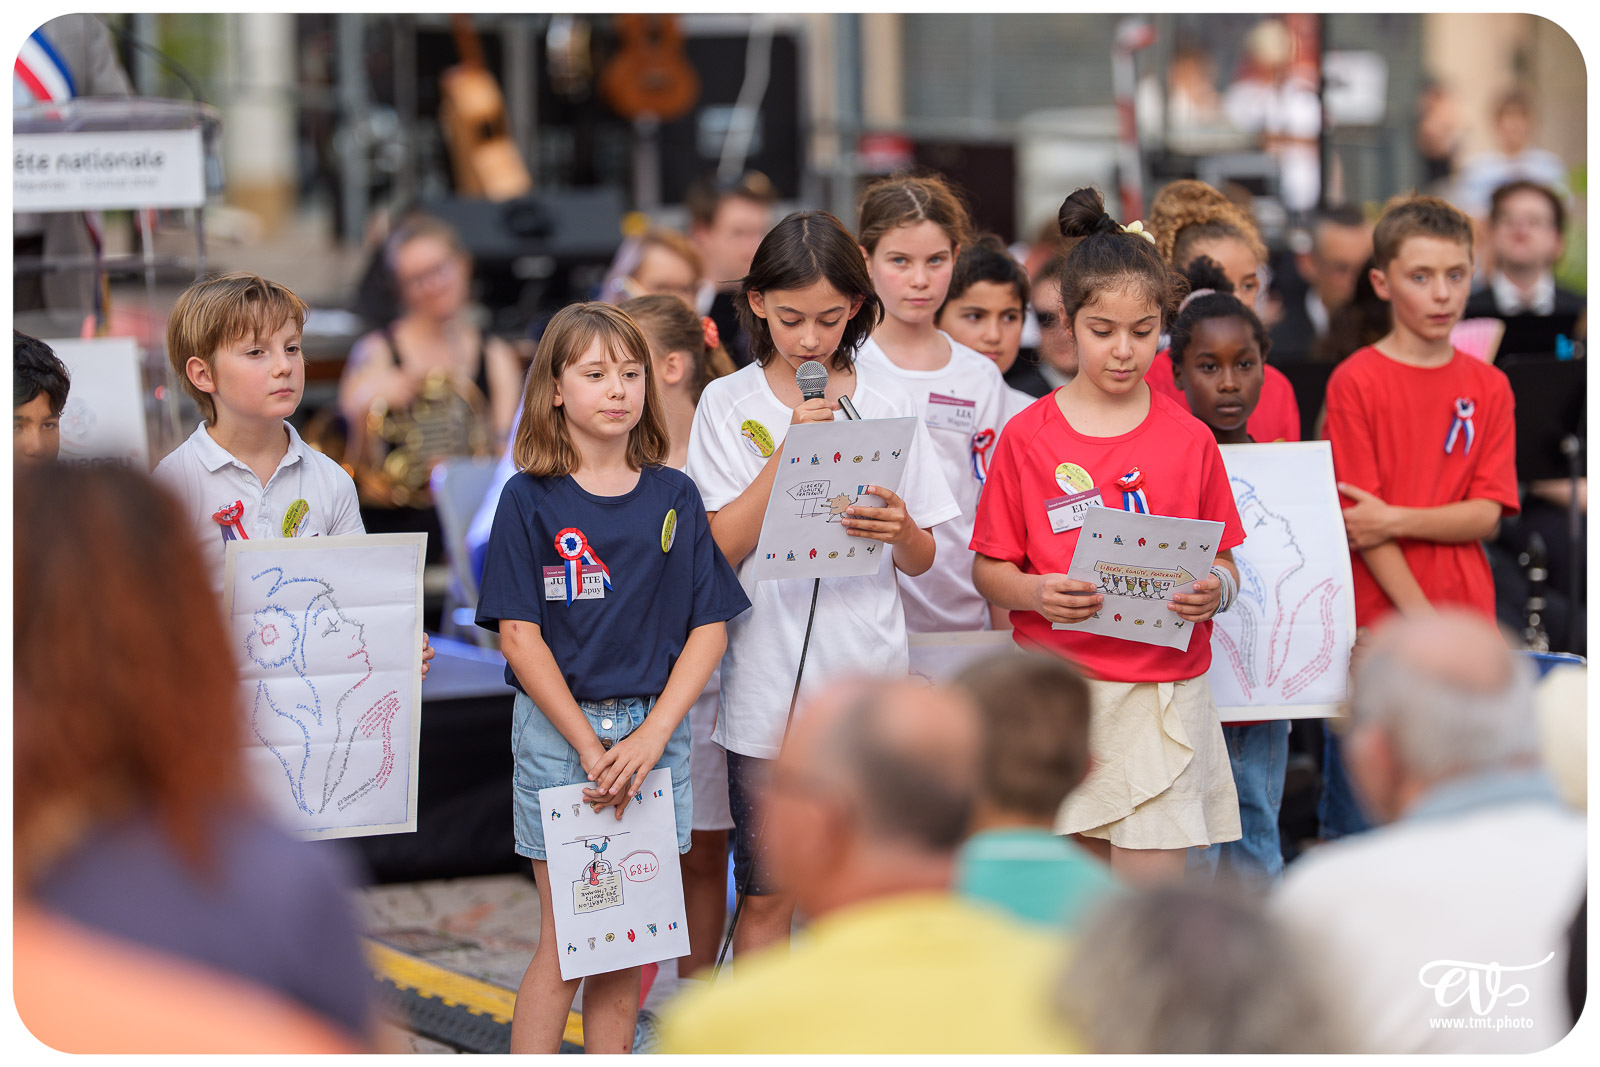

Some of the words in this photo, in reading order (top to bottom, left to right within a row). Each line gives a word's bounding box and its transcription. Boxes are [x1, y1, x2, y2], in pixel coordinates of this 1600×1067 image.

[14, 152, 49, 171] ête
[57, 150, 164, 172] nationale
[956, 408, 971, 420] LIA
[1073, 513, 1086, 522] Cali
[551, 576, 600, 585] JUTTE
[629, 863, 656, 876] 1789
[578, 894, 620, 909] DÉCLARATION
